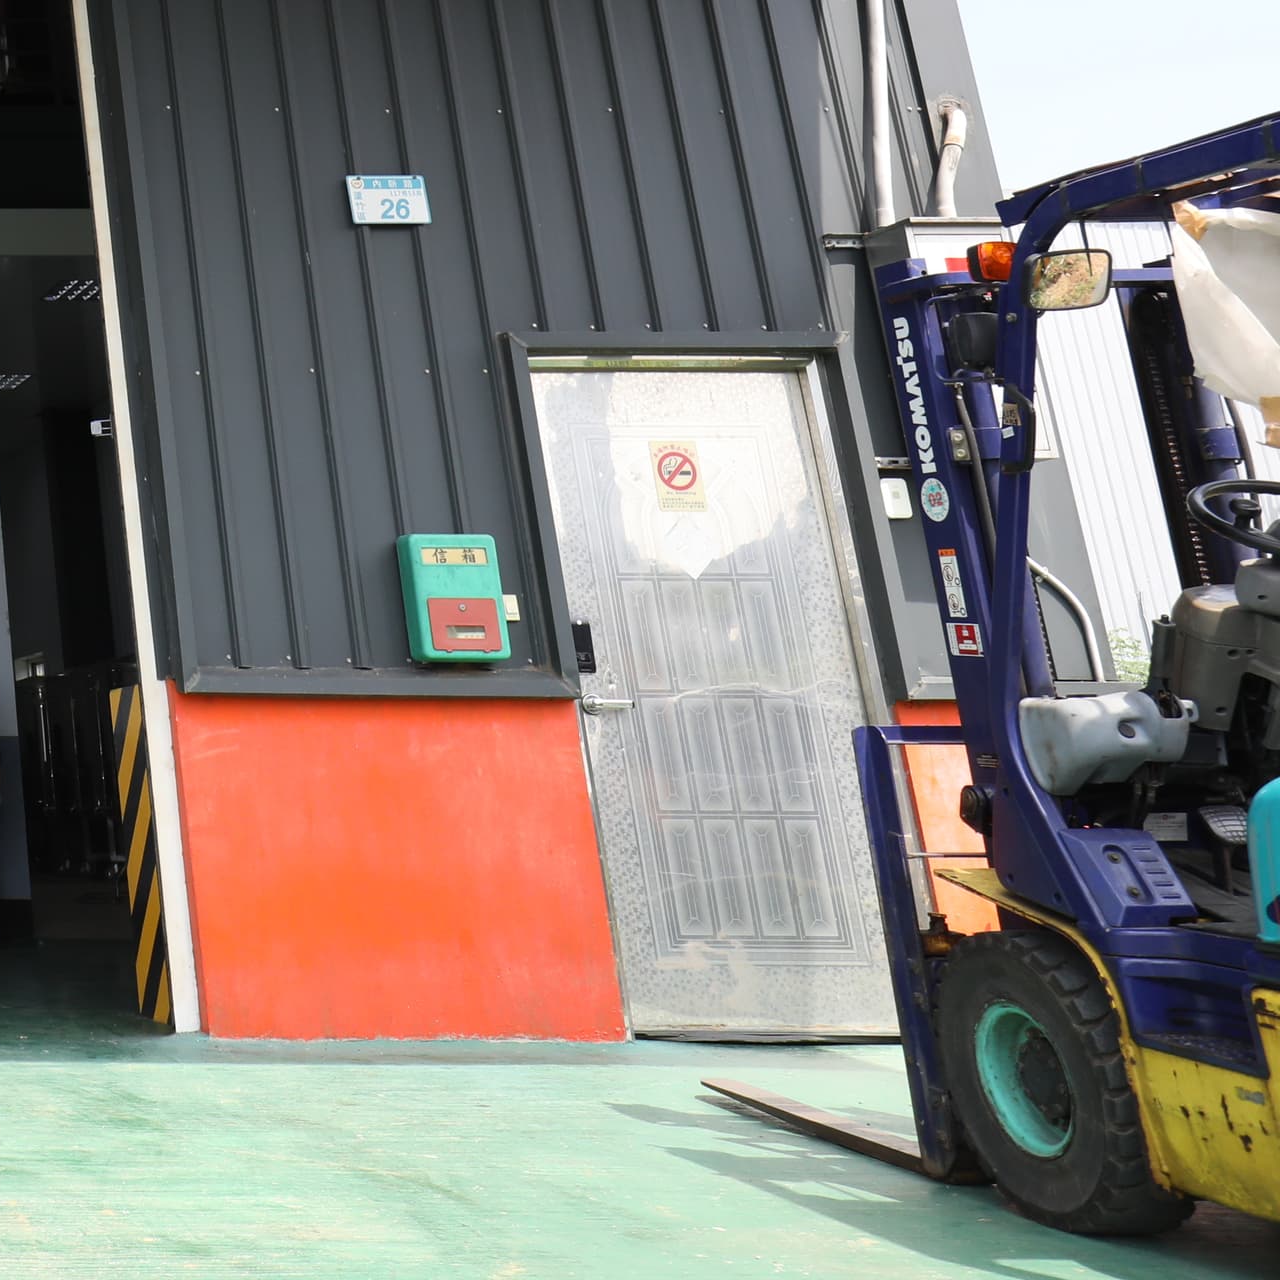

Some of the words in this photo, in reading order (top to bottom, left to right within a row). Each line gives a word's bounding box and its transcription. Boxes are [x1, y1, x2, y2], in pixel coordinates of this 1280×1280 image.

[381, 198, 410, 220] 26
[893, 317, 937, 474] KOMATSU
[432, 548, 476, 564] 信箱
